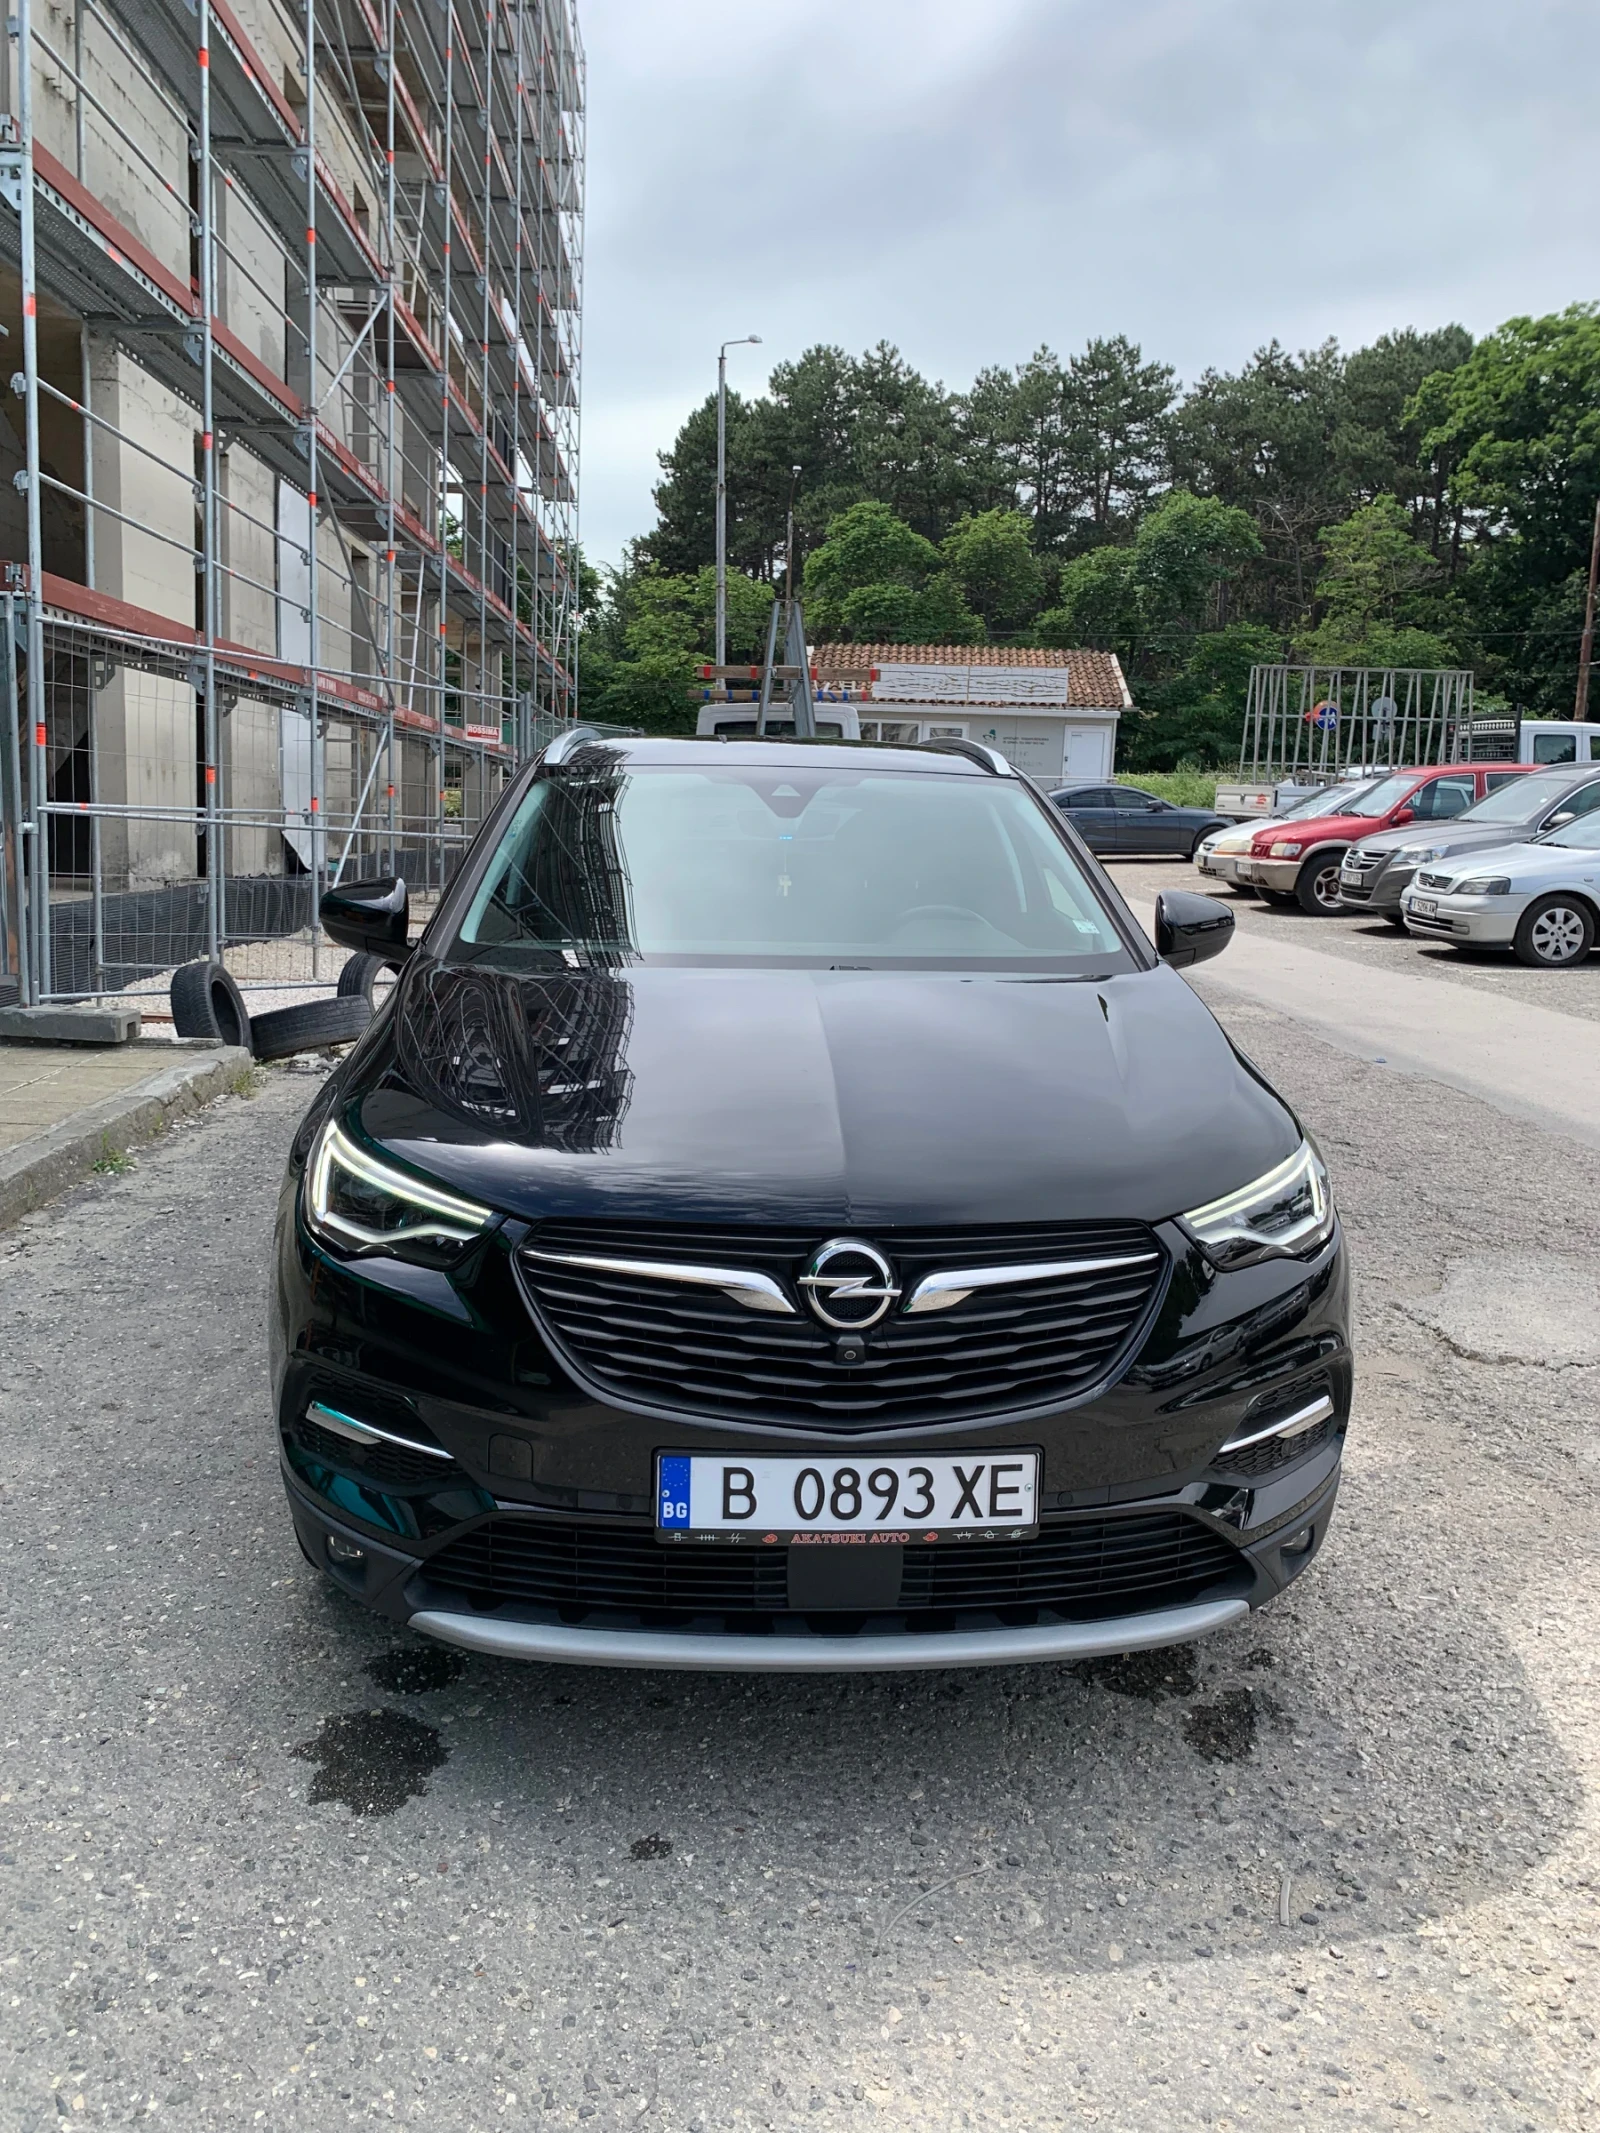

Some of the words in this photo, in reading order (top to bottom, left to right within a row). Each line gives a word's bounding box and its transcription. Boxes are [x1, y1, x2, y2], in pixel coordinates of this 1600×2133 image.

[468, 725, 498, 736] ROSSIMA
[722, 1467, 757, 1520] B
[794, 1466, 935, 1521] 0893
[950, 1463, 1023, 1519] XE
[663, 1502, 687, 1518] BG
[791, 1533, 866, 1544] AKATSUKI
[869, 1532, 910, 1543] AUTO
